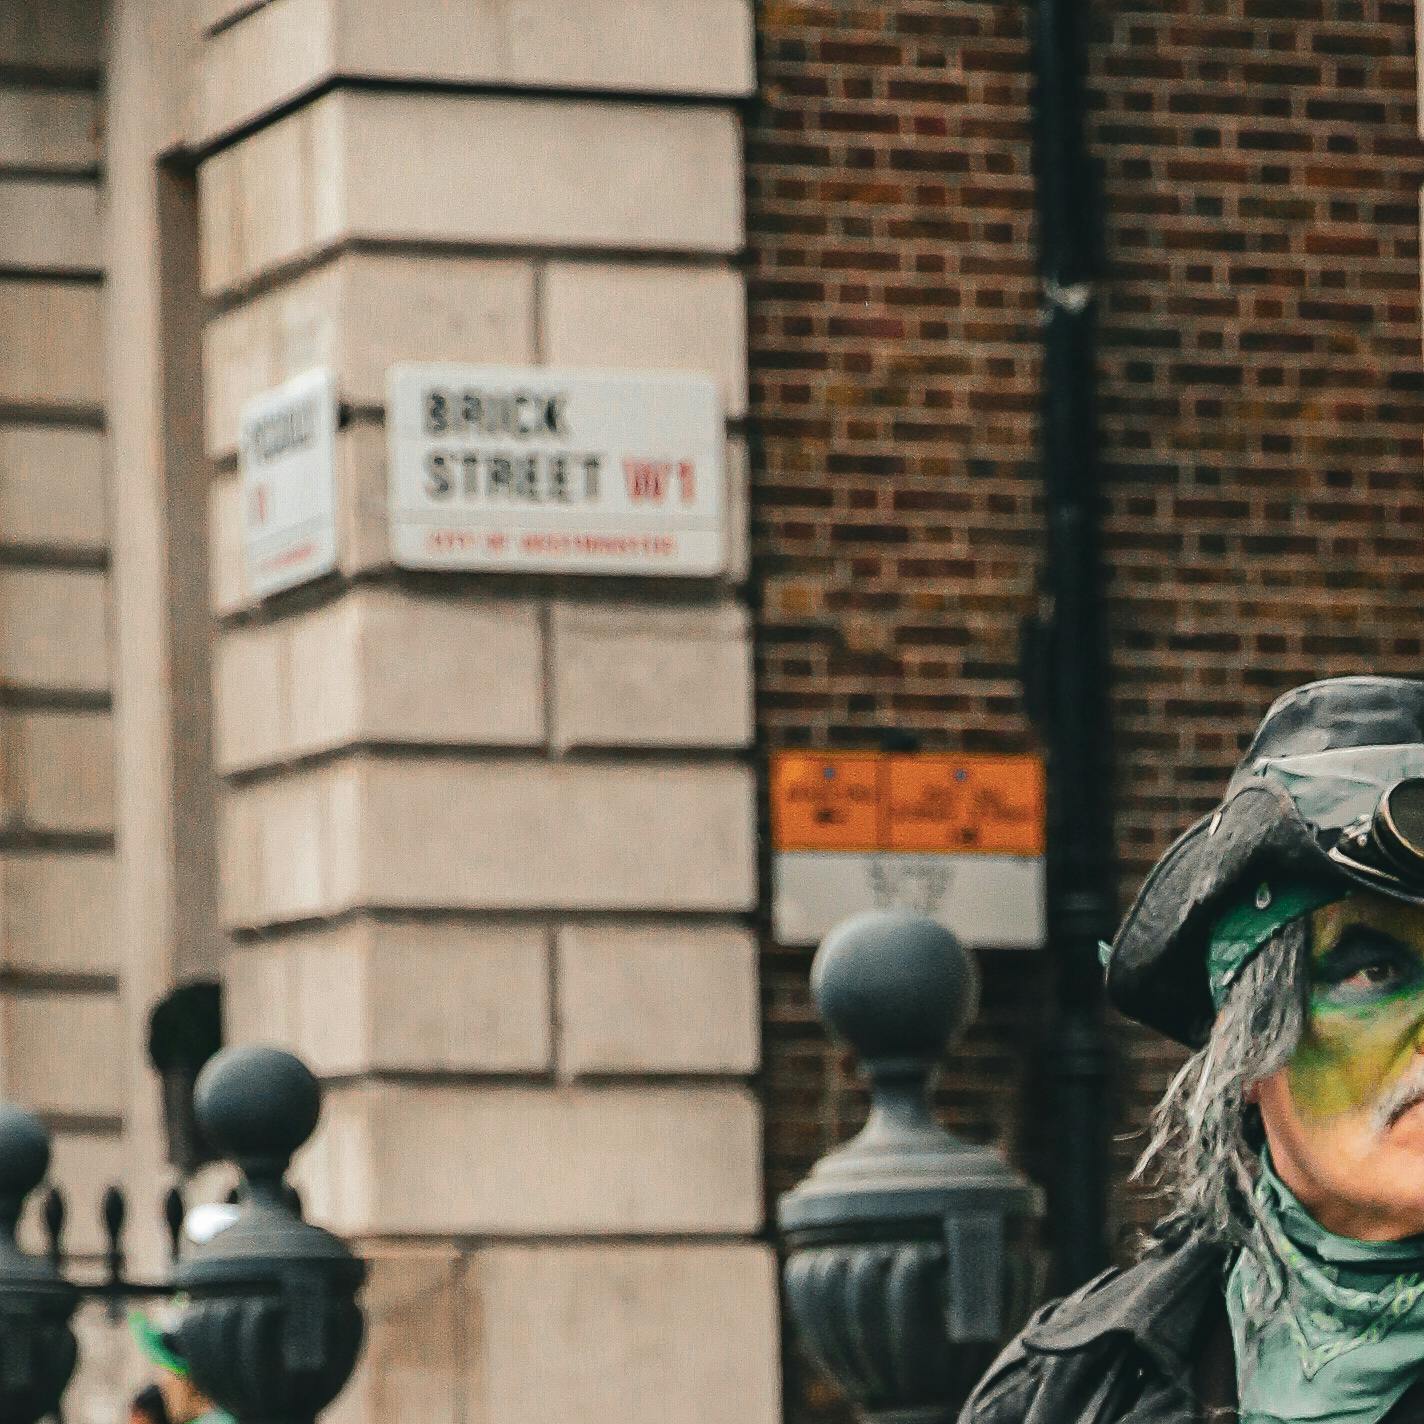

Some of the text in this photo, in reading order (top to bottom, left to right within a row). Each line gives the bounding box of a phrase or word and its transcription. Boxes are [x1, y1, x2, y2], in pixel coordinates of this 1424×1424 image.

[425, 388, 570, 436] BRICK
[426, 450, 697, 504] STREET W1
